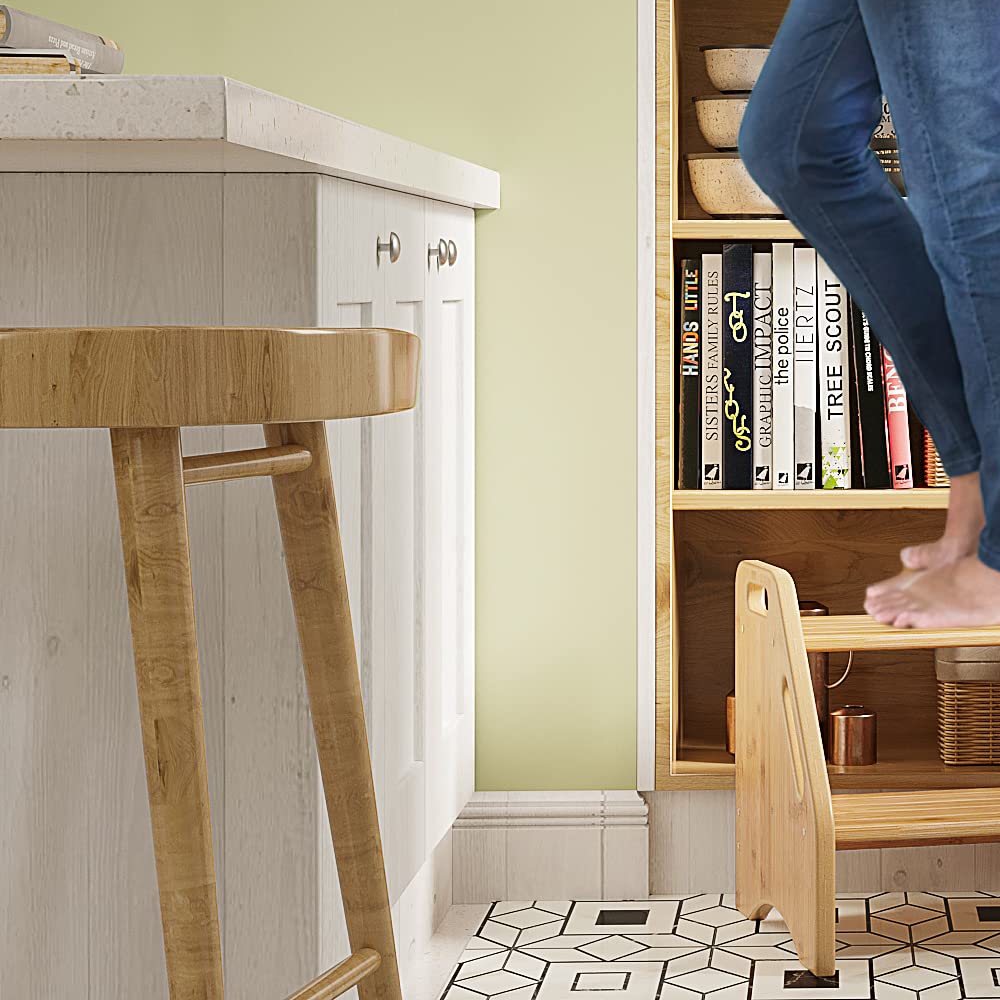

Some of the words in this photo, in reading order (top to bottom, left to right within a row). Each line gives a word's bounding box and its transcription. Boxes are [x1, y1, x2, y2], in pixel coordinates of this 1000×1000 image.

[48, 35, 60, 48] Pizza
[59, 39, 69, 49] and
[68, 42, 81, 55] Bread
[81, 47, 97, 60] Artisan
[684, 269, 699, 311] LITTLE
[707, 270, 719, 315] RULES
[754, 282, 772, 371] IMPACT
[774, 307, 791, 357] police
[825, 280, 842, 352] SCOUT
[682, 321, 699, 376] HANDS
[707, 319, 719, 370] FAMILY
[865, 352, 873, 371] CHORD
[774, 358, 789, 386] the
[827, 364, 844, 420] TREE
[866, 371, 874, 392] SCALES
[705, 374, 719, 441] SISTERS
[758, 374, 772, 448] GRAPHIC
